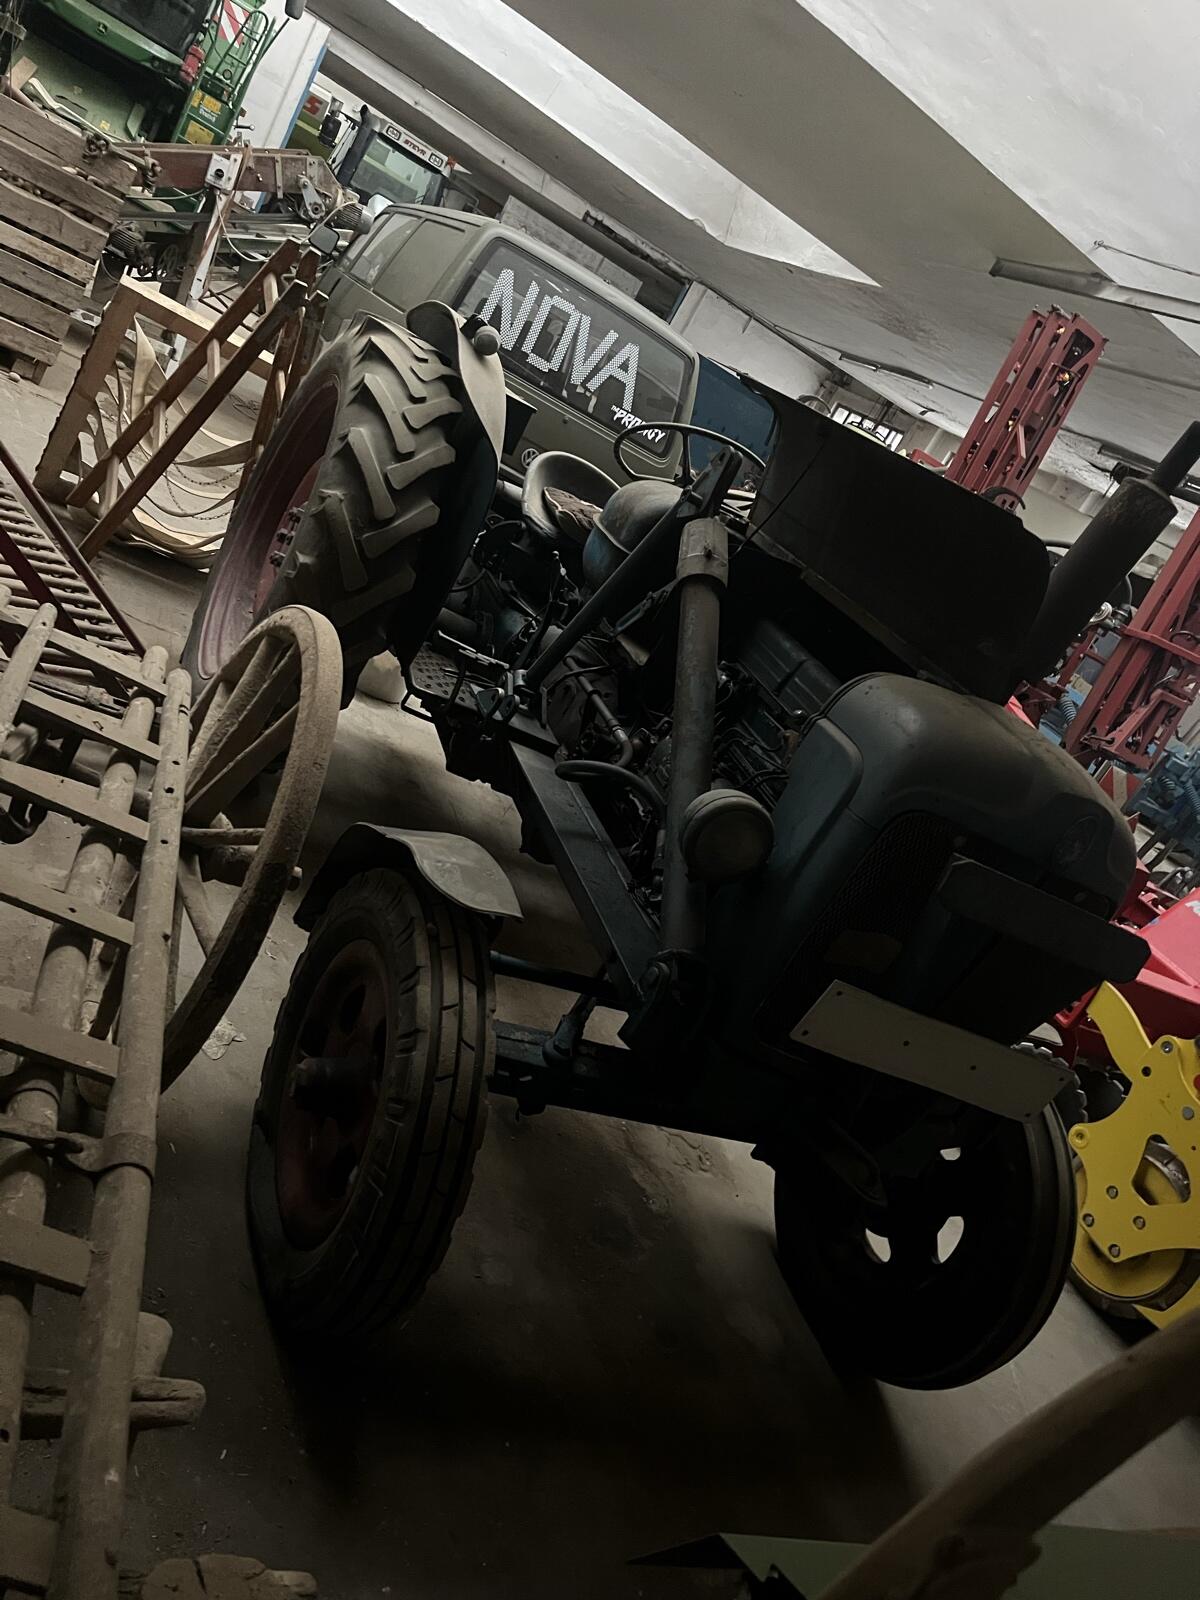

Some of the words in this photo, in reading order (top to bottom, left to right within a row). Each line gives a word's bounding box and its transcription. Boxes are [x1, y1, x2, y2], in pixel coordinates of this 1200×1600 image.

[403, 139, 426, 156] STEYR
[480, 269, 639, 412] NOVA
[613, 409, 666, 443] PROGY
